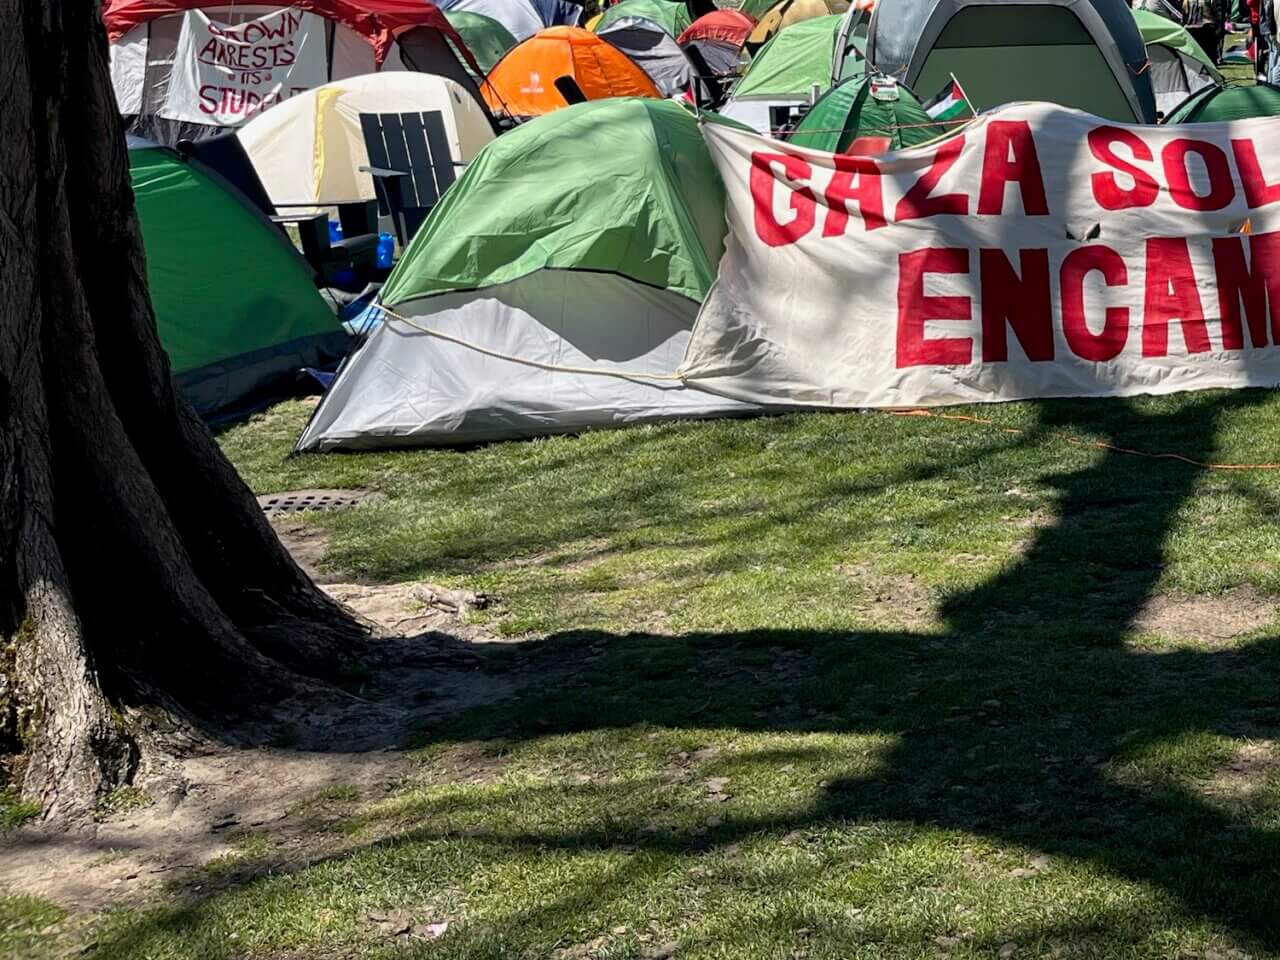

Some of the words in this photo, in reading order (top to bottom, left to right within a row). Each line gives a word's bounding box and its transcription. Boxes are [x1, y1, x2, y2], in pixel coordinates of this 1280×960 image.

[199, 38, 296, 67] ARRESTS
[241, 72, 261, 84] ITS
[749, 120, 1050, 247] GAZA
